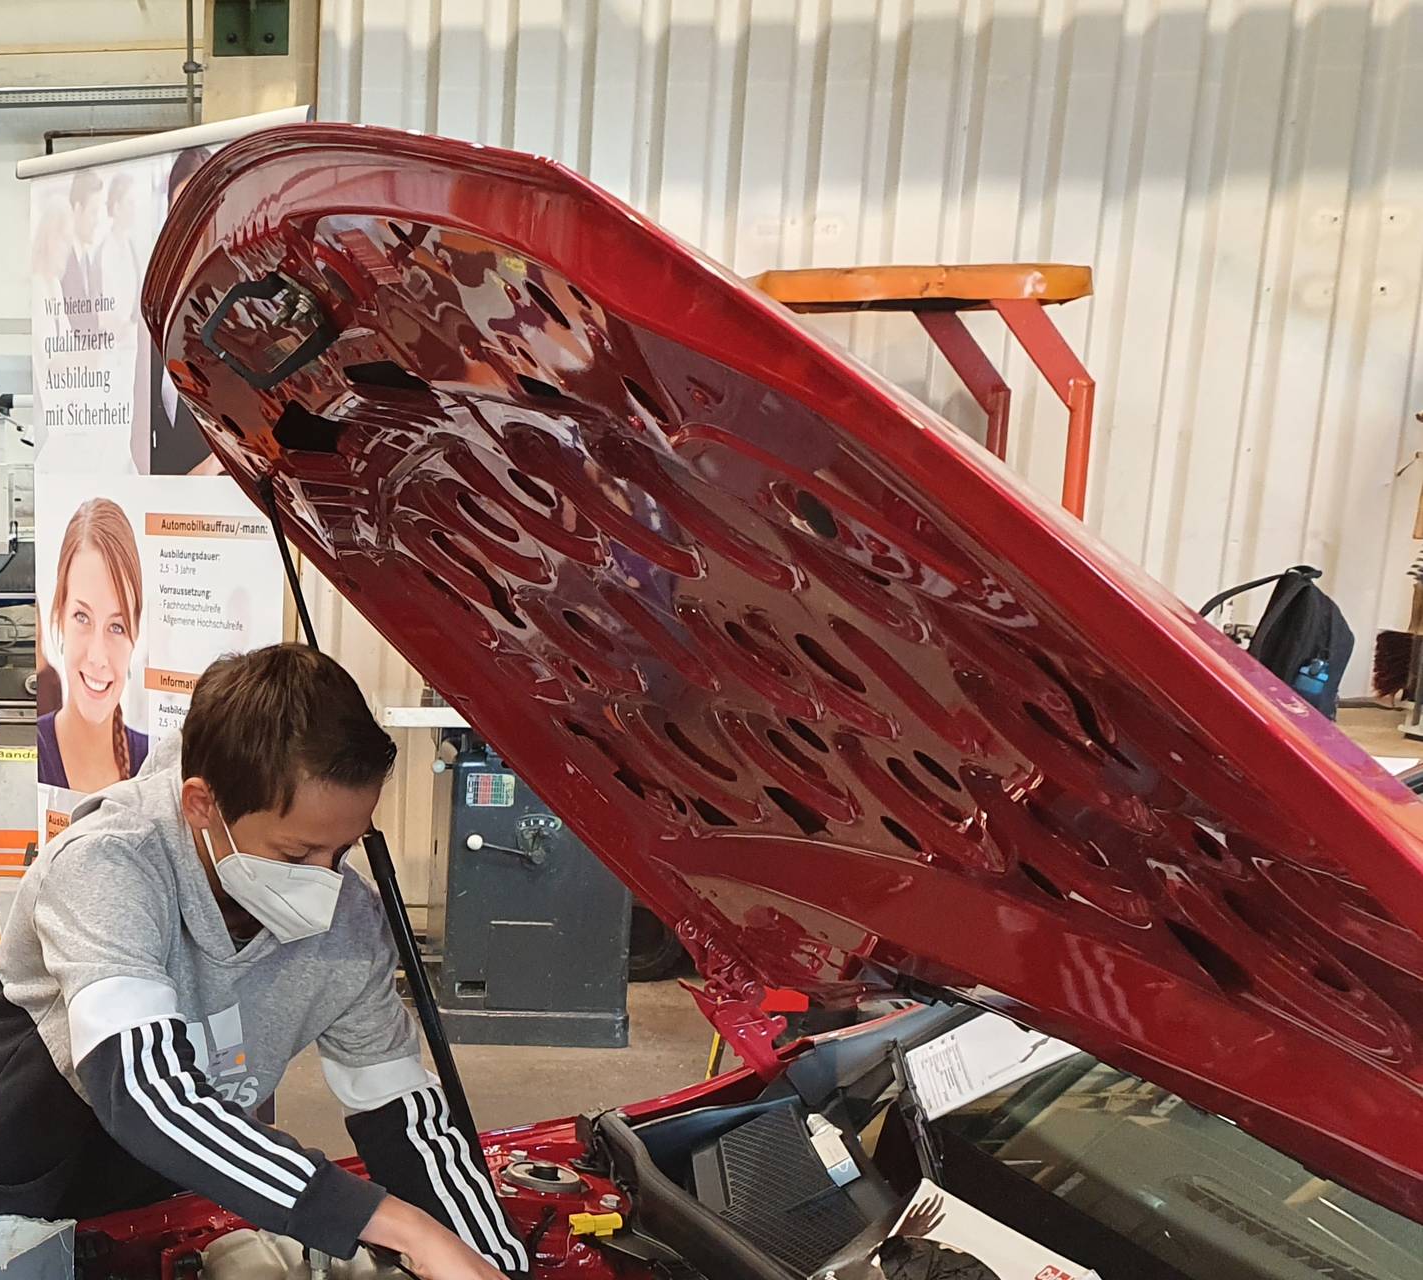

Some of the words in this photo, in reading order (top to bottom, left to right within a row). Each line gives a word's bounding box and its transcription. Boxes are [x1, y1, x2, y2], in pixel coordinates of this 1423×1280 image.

[45, 297, 61, 316] Wir
[63, 296, 92, 315] bieten
[94, 294, 116, 312] eine
[44, 328, 115, 359] qualifizierte
[45, 366, 111, 393] Ausbildung
[45, 404, 64, 426] mit
[67, 402, 130, 426] Sicherheit!
[160, 519, 268, 536] Automobilkauffrau/-mann:
[159, 548, 220, 562] Ausbildungsdauer:
[160, 674, 197, 690] Informati
